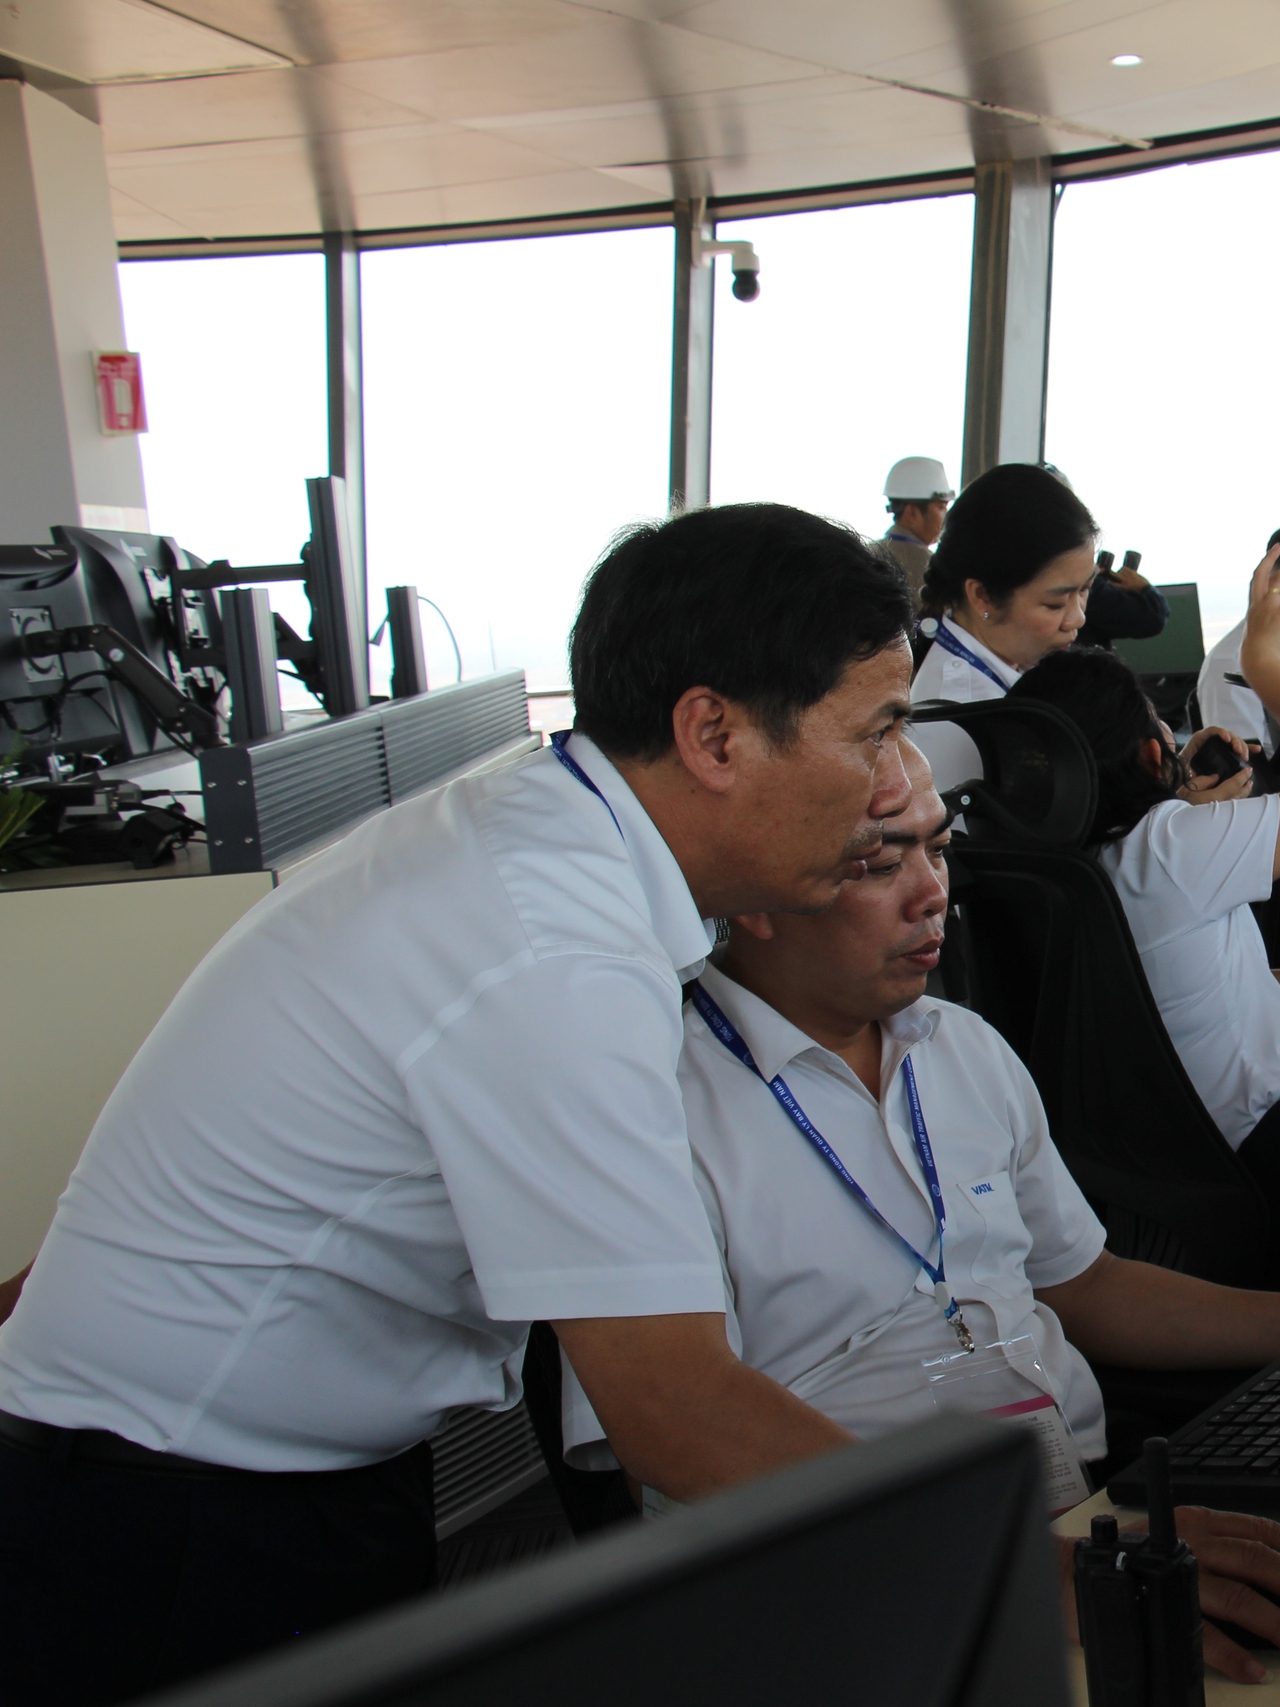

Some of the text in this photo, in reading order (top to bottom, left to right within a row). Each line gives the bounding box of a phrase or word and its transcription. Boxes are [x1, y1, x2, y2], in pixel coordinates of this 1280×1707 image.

[773, 1081, 786, 1096] NAM
[792, 1108, 804, 1122] BAY
[916, 1111, 925, 1134] TRAFFIC
[920, 1133, 928, 1144] AIR
[822, 1145, 829, 1154] TY
[922, 1144, 934, 1167] VIETNAM
